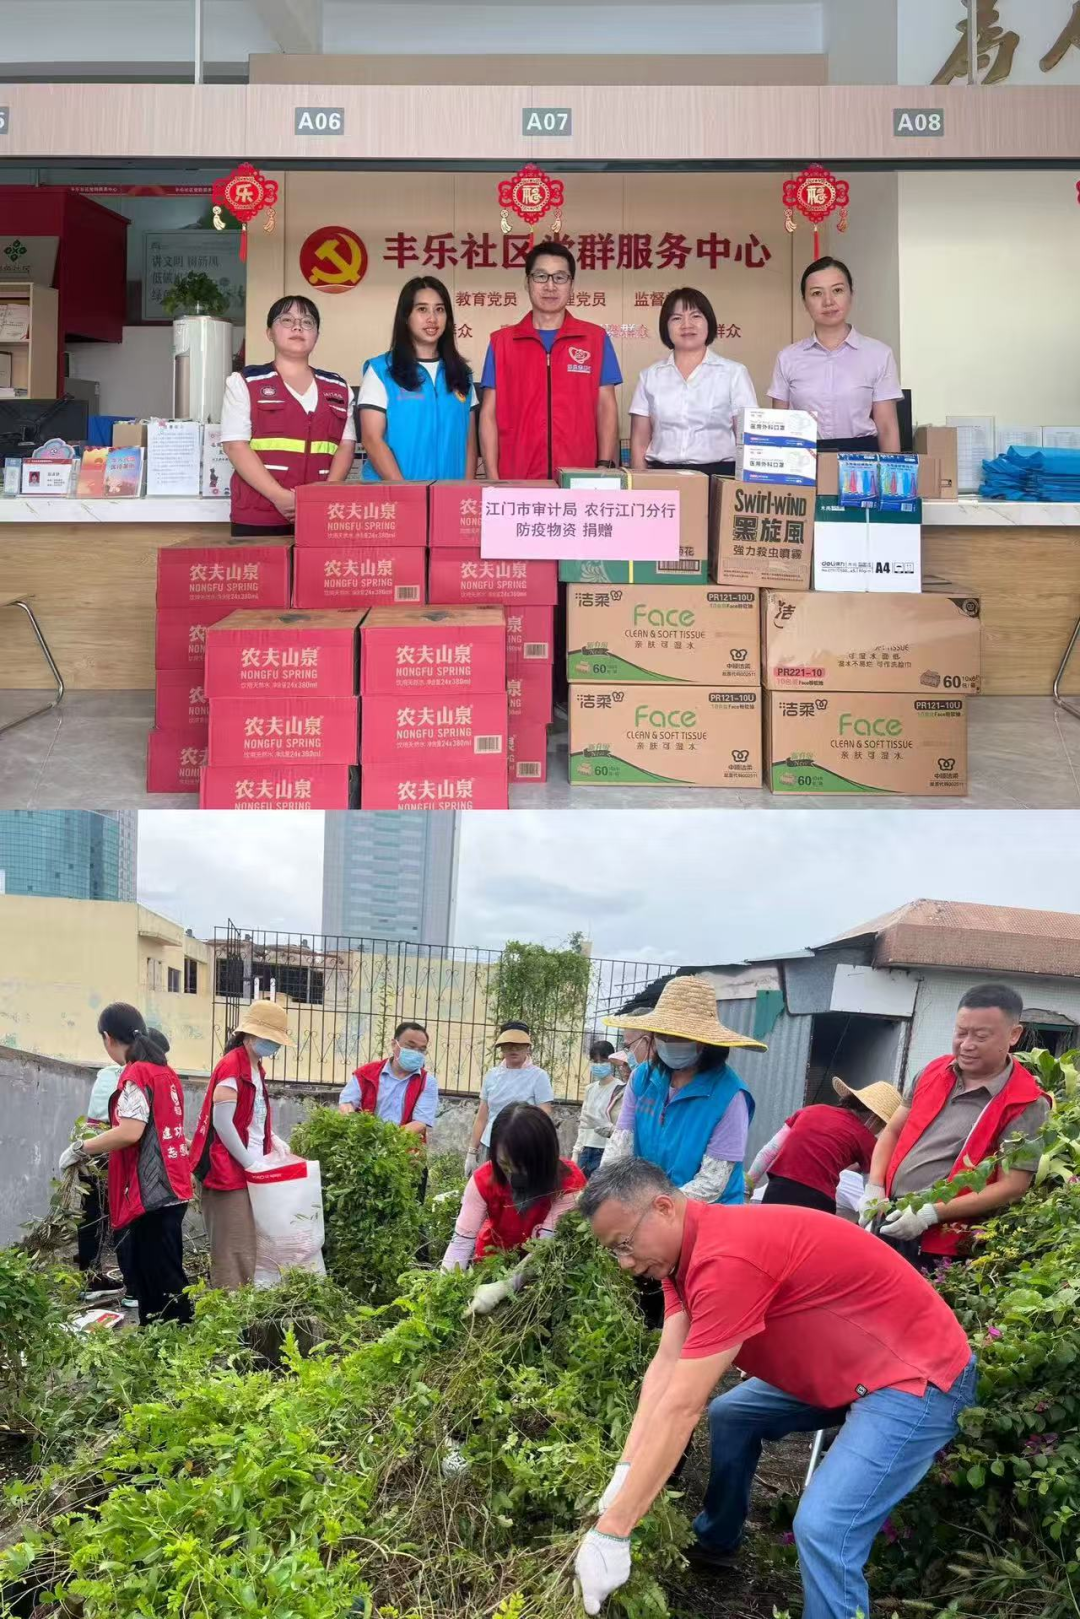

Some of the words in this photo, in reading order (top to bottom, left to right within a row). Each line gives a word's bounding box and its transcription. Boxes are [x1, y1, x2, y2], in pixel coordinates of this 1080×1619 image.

[298, 112, 341, 130] A06
[526, 112, 568, 130] A07
[897, 113, 941, 131] A08
[456, 291, 517, 306] 教育党员
[327, 502, 396, 520] 农夫山泉
[486, 501, 577, 517] 江门市审计局
[584, 502, 676, 519] 农行江门分行
[327, 521, 361, 531] NONGFU
[365, 521, 396, 530] SPRING
[516, 522, 577, 538] 防疫物资
[583, 522, 613, 538] 捐赠
[189, 563, 259, 581] 农夫山泉
[324, 559, 393, 577] 农夫山泉
[460, 561, 528, 579] 农夫山泉
[875, 562, 890, 574] A4
[189, 583, 223, 592] NONGFU
[226, 582, 259, 591] SPRING
[324, 578, 358, 587] NONGFU
[362, 578, 393, 587] SPRING
[461, 581, 494, 590] NONGFU
[497, 580, 527, 589] SPRING
[575, 592, 610, 608] 洁柔
[708, 593, 753, 601] PR121-10U
[633, 604, 695, 627] Face
[625, 629, 648, 638] CLEAN
[650, 630, 656, 638] &
[658, 630, 678, 638] SOFT
[680, 630, 706, 639] TISSUE
[241, 648, 318, 668] 农夫山泉
[396, 644, 471, 664] 农夫山泉
[241, 670, 278, 680] NONGFU
[282, 670, 318, 679] SPRING
[396, 667, 433, 677] NONGFU
[437, 666, 471, 676] SPRING
[593, 664, 606, 674] 60
[777, 668, 822, 677] PR221-10
[943, 675, 961, 688] 60
[577, 694, 612, 709] 洁柔
[710, 694, 755, 702] PR121-10U
[396, 706, 473, 726] 农夫山泉
[635, 705, 696, 727] Face
[779, 702, 815, 717] 洁柔
[244, 716, 322, 736] 农夫山泉
[839, 713, 902, 736] Face
[397, 729, 434, 739] NONGFU
[438, 728, 472, 738] SPRING
[627, 731, 650, 739] CLEAN
[660, 731, 679, 740] SOFT
[681, 731, 707, 740] TISSUE
[244, 739, 282, 749] NONGFU
[286, 738, 322, 748] SPRING
[830, 740, 855, 748] CLEAN
[856, 740, 862, 748] &
[864, 740, 884, 748] SOFT
[886, 740, 913, 749] TISSUE
[594, 766, 608, 776] 60
[797, 775, 812, 786] 60
[235, 779, 312, 799] 农夫山泉
[398, 779, 473, 800] 农夫山泉
